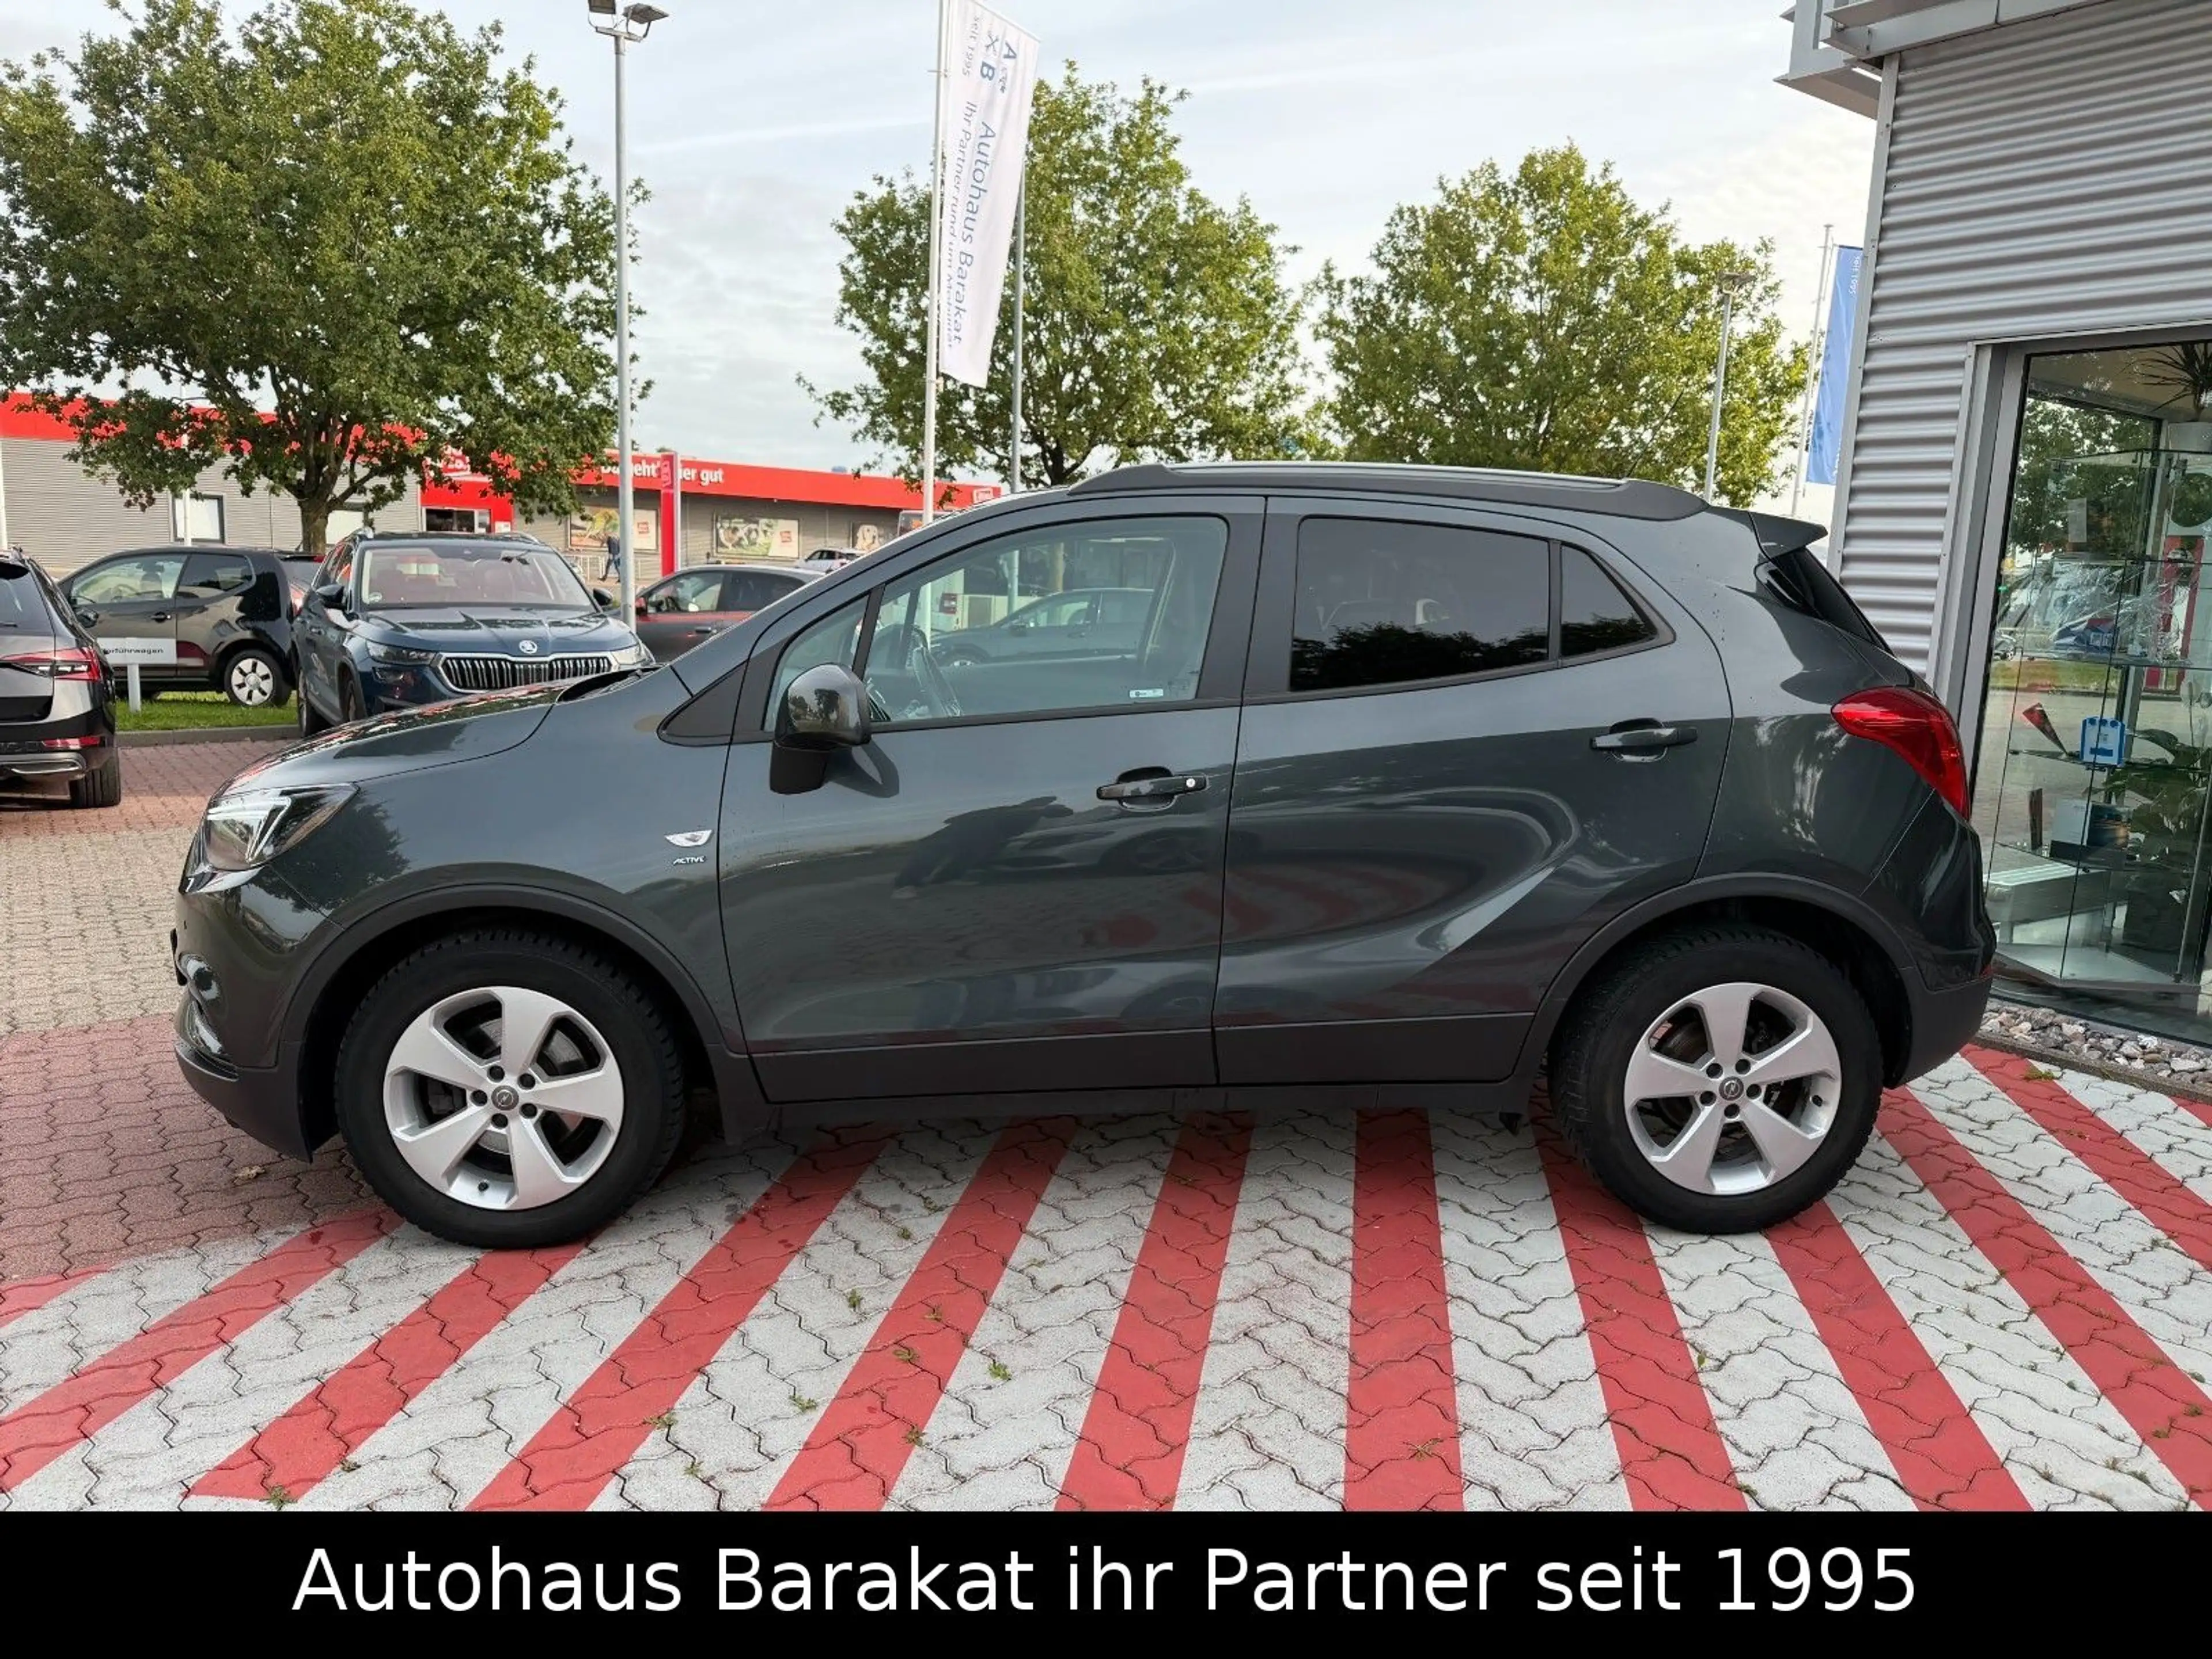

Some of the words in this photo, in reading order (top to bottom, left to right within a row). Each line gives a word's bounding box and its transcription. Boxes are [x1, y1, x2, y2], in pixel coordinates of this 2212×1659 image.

[962, 46, 975, 77] 1995
[1003, 40, 1017, 59] A
[980, 60, 995, 81] B
[963, 101, 978, 126] Ihr
[953, 129, 972, 194] Partner
[961, 121, 996, 244] Autohaus
[953, 251, 974, 344] Barakat
[699, 467, 725, 487] gut
[104, 647, 164, 655] orführwagen
